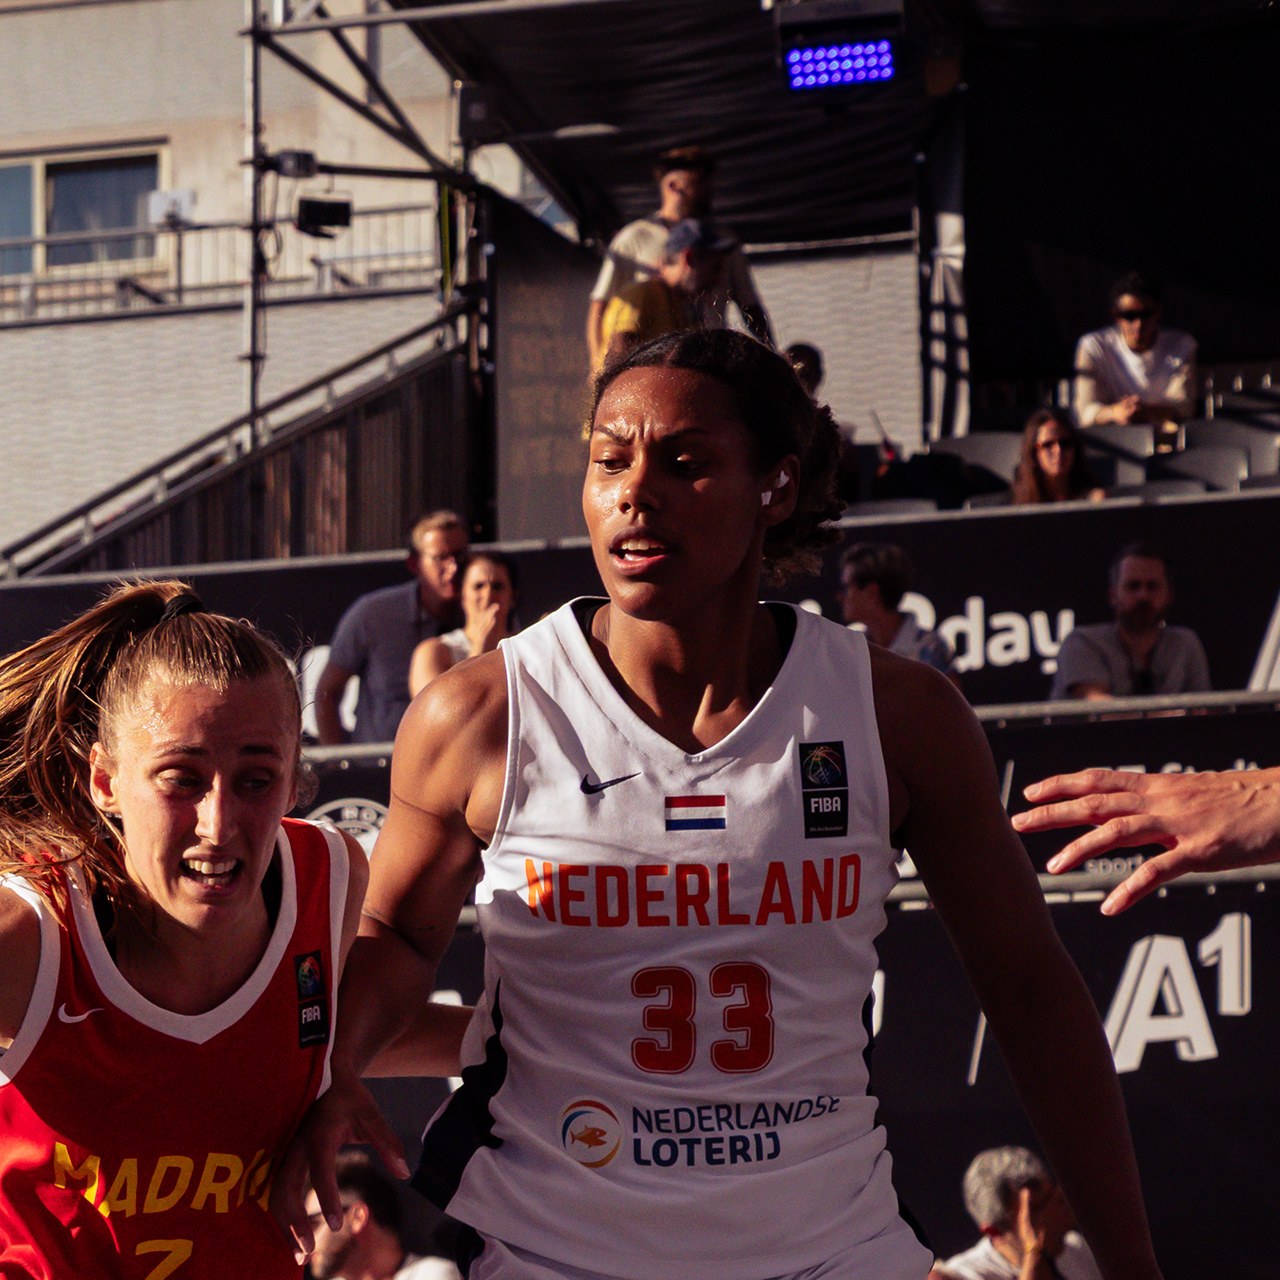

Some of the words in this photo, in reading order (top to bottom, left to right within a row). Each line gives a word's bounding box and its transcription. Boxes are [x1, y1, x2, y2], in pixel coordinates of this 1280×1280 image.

[810, 796, 841, 813] FIBA
[524, 853, 862, 928] NEDERLAND
[630, 960, 776, 1075] 33
[632, 1094, 841, 1135] NEDERLANDSE
[632, 1132, 781, 1167] LOTERIJ
